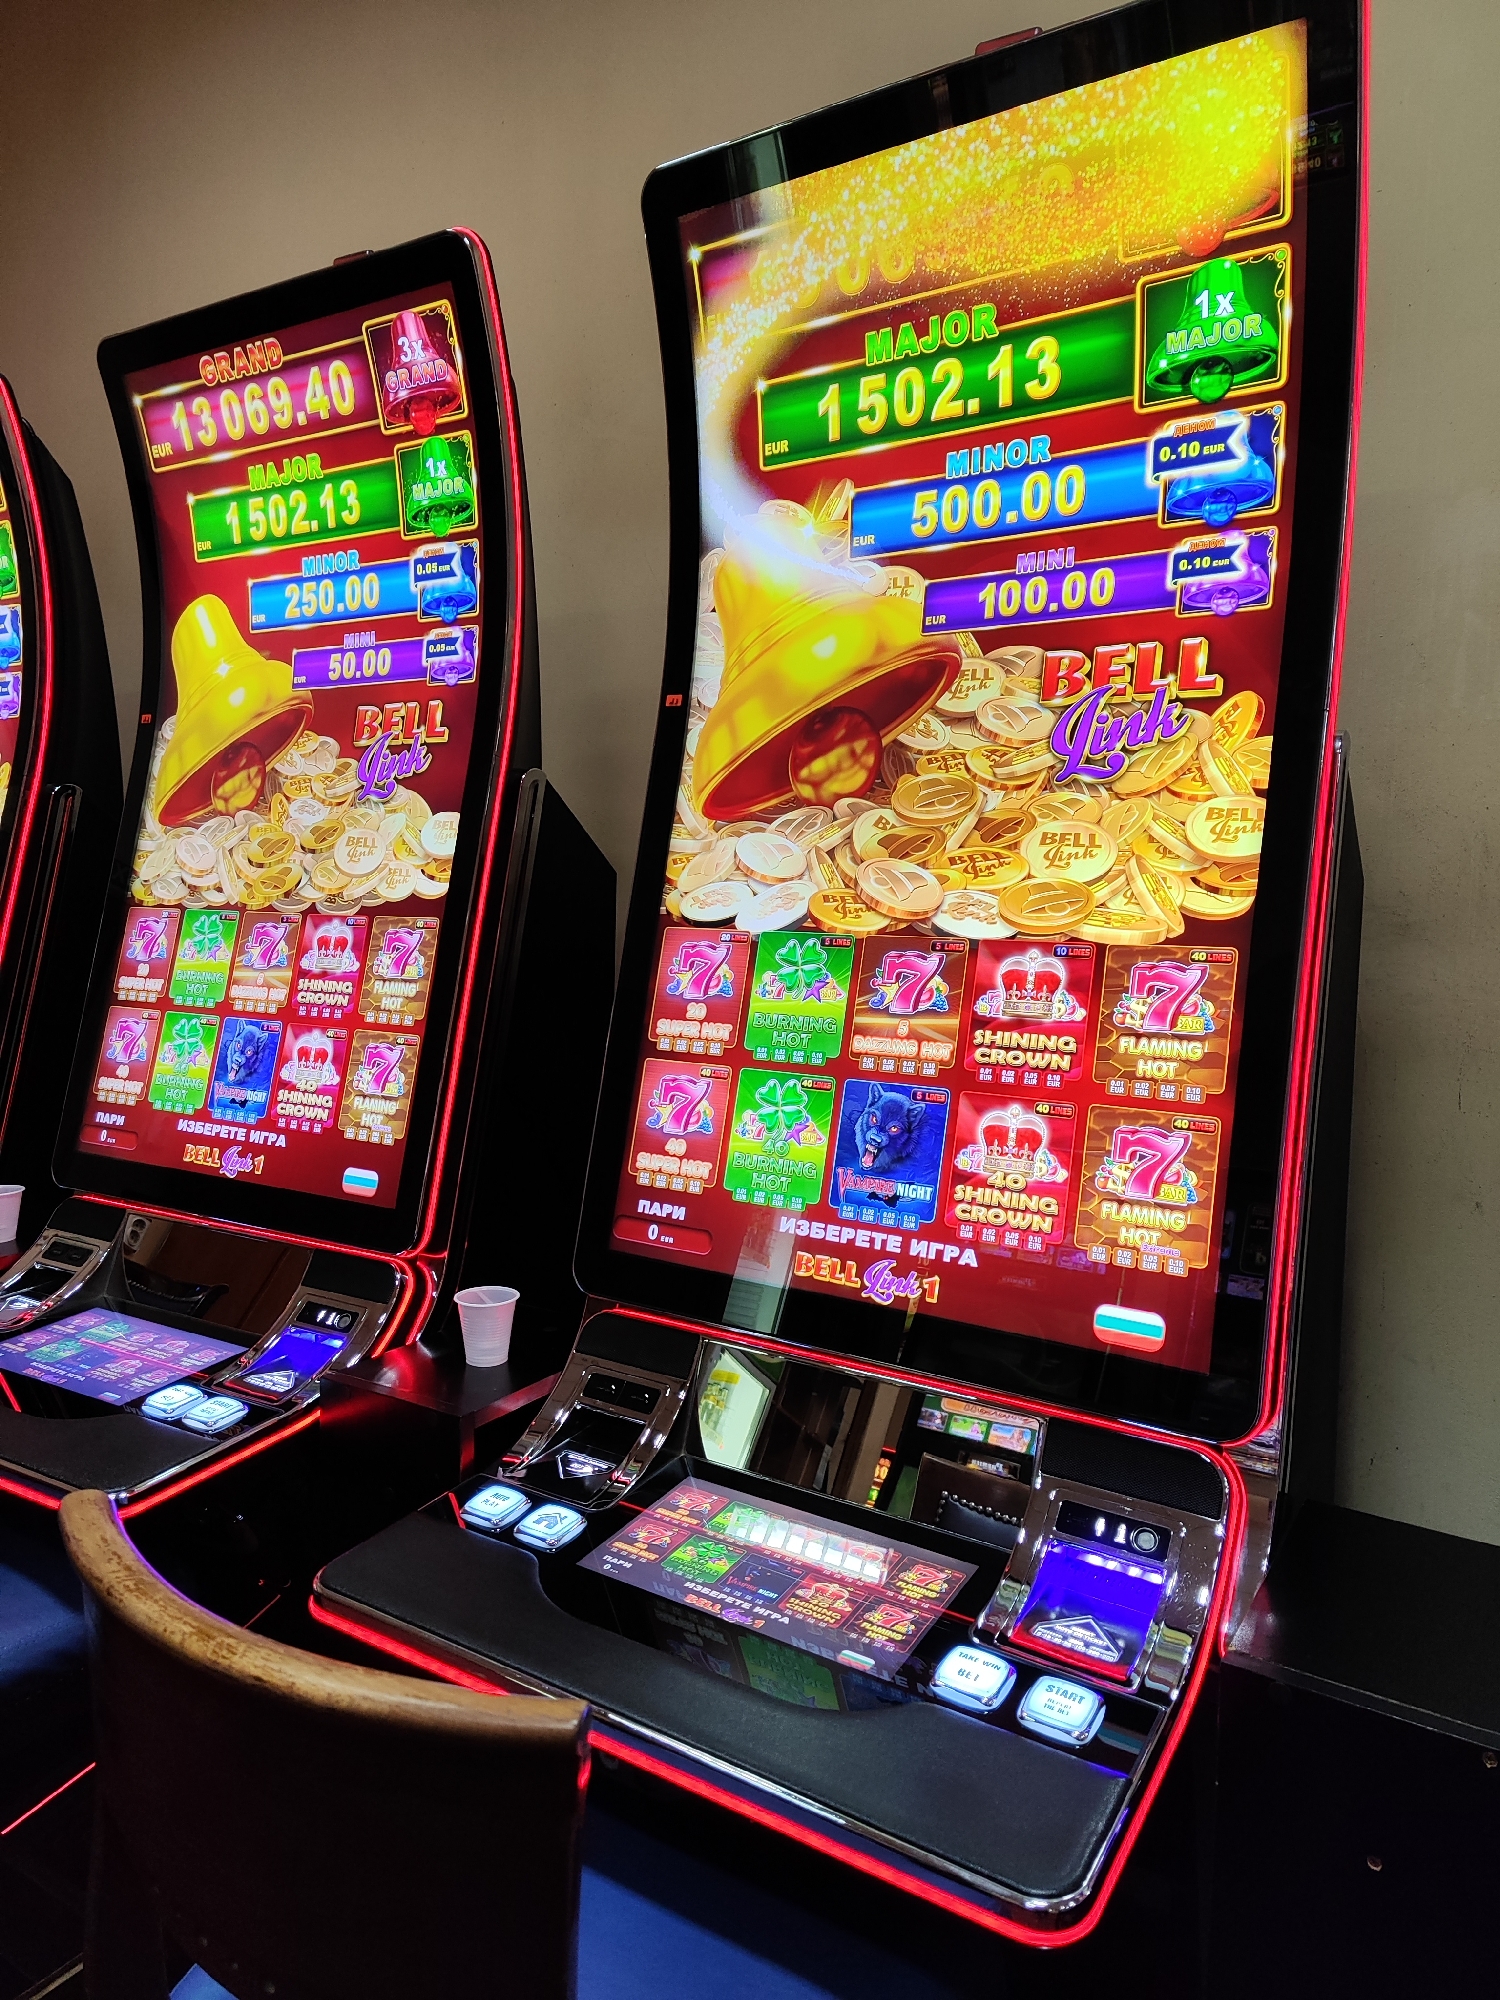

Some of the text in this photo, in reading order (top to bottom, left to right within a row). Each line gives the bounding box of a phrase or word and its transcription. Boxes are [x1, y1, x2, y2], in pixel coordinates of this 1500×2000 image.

[1193, 289, 1235, 319] 1x
[865, 303, 998, 365] MAJOR
[1166, 314, 1262, 356] MAJOR
[398, 337, 425, 362] 3x
[200, 337, 283, 386] GRAND
[385, 359, 448, 392] GRAND
[1173, 418, 1217, 437] ДЕНОМ
[151, 443, 173, 459] EUR
[764, 439, 788, 457] EUR
[946, 435, 1051, 480] MINOR
[1159, 441, 1225, 462] 0.10 EUR
[248, 453, 322, 490] MAJOR
[426, 458, 447, 478] 1x
[412, 478, 464, 500] MAJOR
[911, 465, 1086, 538] 500.00
[197, 541, 211, 551] EUR
[853, 534, 876, 546] EUR
[1189, 538, 1226, 552] ДЕНОМ
[302, 551, 360, 577] MINOR
[417, 563, 450, 575] 0.05 EUR
[1016, 547, 1075, 574] MINI
[1179, 556, 1211, 570] 0.10
[285, 573, 379, 619] 250.00
[978, 568, 1115, 620] 100.00
[252, 614, 265, 623] EUR
[925, 614, 946, 625] EUR
[344, 631, 376, 649] MINI
[429, 644, 445, 652] 0.05
[329, 648, 391, 680] 50.00
[1040, 636, 1224, 704] BELL
[294, 676, 306, 684] EUR
[354, 700, 449, 747] BELL
[1050, 685, 1195, 783] Link
[356, 728, 432, 801] Link
[345, 836, 378, 848] BELL
[1039, 831, 1102, 848] BELL
[947, 852, 1006, 866] BELL
[1044, 844, 1098, 870] Link
[833, 938, 851, 946] LINES
[1056, 947, 1090, 957] 10 LINES
[1191, 951, 1232, 962] 40 LINES
[186, 984, 208, 995] HOT
[297, 978, 353, 994] SHINING
[373, 980, 417, 997] FLAMING
[297, 992, 349, 1007] CROWN
[381, 997, 404, 1010] HOT
[686, 1002, 707, 1020] 20
[656, 1019, 733, 1041] SUPER HOT
[753, 1012, 836, 1033] BURNING
[897, 1019, 909, 1036] 5
[772, 1031, 811, 1048] HOT
[853, 1035, 953, 1061] DAZZLING HOT
[973, 1030, 1077, 1053] SHINING
[1119, 1036, 1203, 1061] FLAMING
[974, 1047, 1071, 1071] CROWN
[1136, 1059, 1179, 1079] HOT
[296, 1080, 317, 1092] 40
[802, 1079, 813, 1088] 40
[165, 1088, 187, 1100] HOT
[246, 1090, 267, 1103] NIGHT
[277, 1089, 332, 1108] SHINING
[925, 1093, 946, 1102] LINES
[277, 1104, 329, 1121] CROWN
[354, 1096, 397, 1115] FLAMING
[1036, 1104, 1073, 1115] 40 LINES
[96, 1112, 125, 1125] ПАРИ
[360, 1114, 383, 1127] HOT
[1174, 1119, 1215, 1130] 40 LINES
[177, 1119, 286, 1147] ИЗБЕРЕТЕ ИГРА
[665, 1138, 687, 1156] 40
[762, 1139, 789, 1157] 40
[183, 1144, 264, 1178] BELL Link 1
[636, 1152, 712, 1179] SUPER HOT
[732, 1152, 816, 1178] BURNING
[751, 1172, 791, 1192] HOT
[987, 1171, 1027, 1191] 40
[896, 1182, 933, 1201] NIGHT
[954, 1185, 1059, 1215] SHINING
[638, 1200, 686, 1220] ПАРИ
[955, 1204, 1053, 1233] CROWN
[1101, 1200, 1187, 1232] FLAMING
[648, 1224, 659, 1240] 0
[1029, 1235, 1041, 1243] 0.10
[1118, 1226, 1161, 1247] HOT
[779, 1217, 978, 1267] ИЗБЕРЕТЕ ИГРА
[1005, 1238, 1018, 1246] EUR
[1028, 1242, 1041, 1250] EUR
[1092, 1253, 1183, 1274] EUR EUR EUR EUR
[1118, 1250, 1131, 1258] 0.02
[794, 1251, 940, 1305] BELL Link 1
[602, 1555, 632, 1569] ПАРИ
[684, 1582, 791, 1624] ИЗБЕРЕТЕ ИГРА
[757, 1588, 779, 1599] NIGHT
[901, 1589, 923, 1599] HOT
[683, 1594, 722, 1614] BELL
[785, 1603, 837, 1624] CROWN
[788, 1597, 841, 1619] SHINING
[959, 1652, 1001, 1671] TAKE WIN
[957, 1667, 979, 1681] BET
[1045, 1684, 1085, 1704] START
[1044, 1703, 1055, 1711] THE
